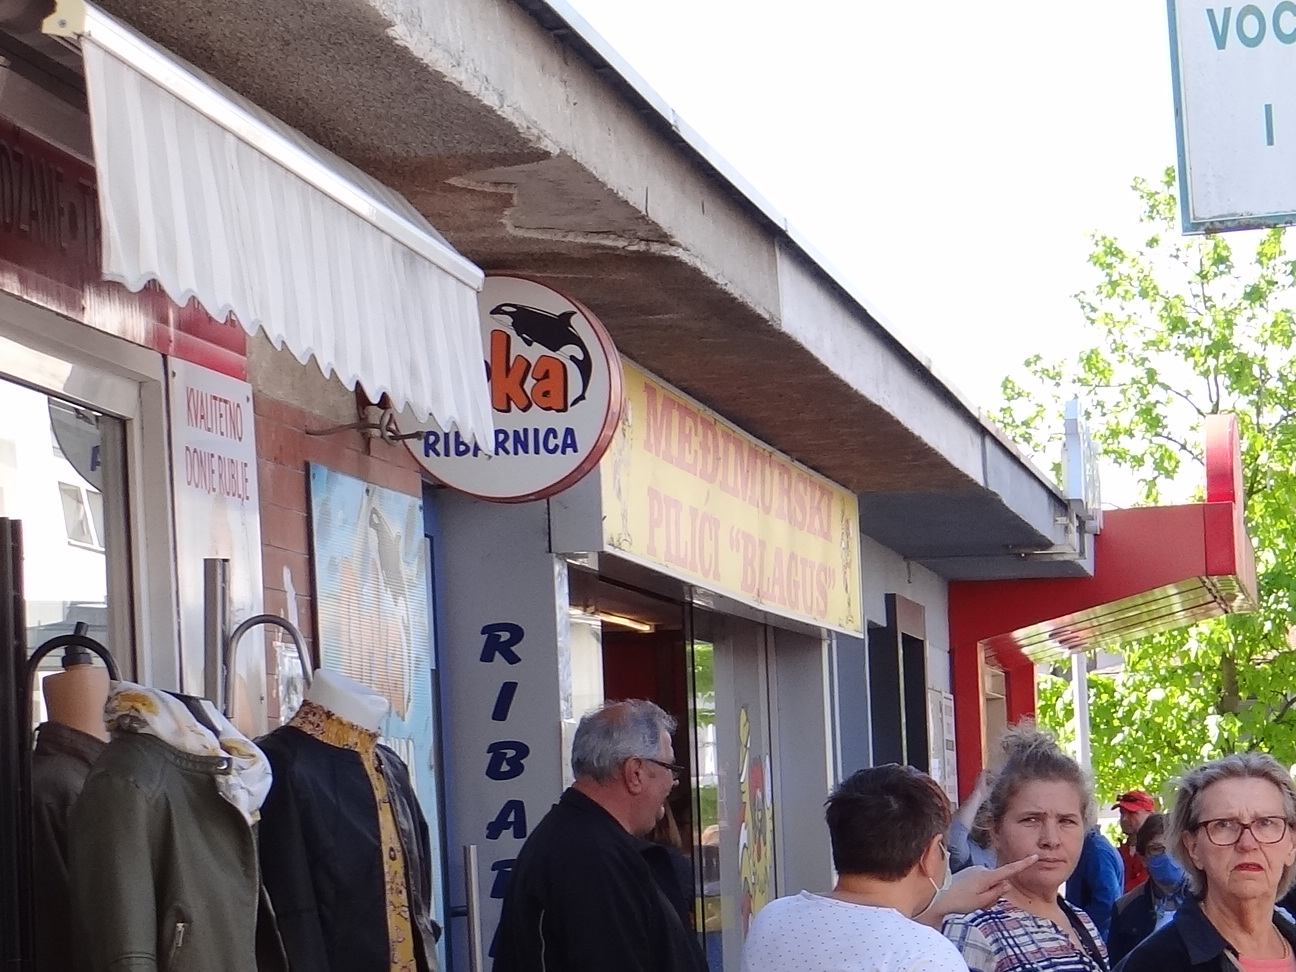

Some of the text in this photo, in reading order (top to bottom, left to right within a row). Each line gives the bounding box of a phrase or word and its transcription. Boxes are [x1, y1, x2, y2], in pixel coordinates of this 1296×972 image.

[1264, 103, 1275, 147] I
[185, 385, 244, 443] KVALITETNO
[484, 329, 569, 414] ka
[184, 445, 250, 503] DONJE RUBLJE
[643, 381, 835, 543] MEĐIMURSKI
[646, 486, 722, 583] PILIĆI
[478, 621, 532, 959] RIBA
